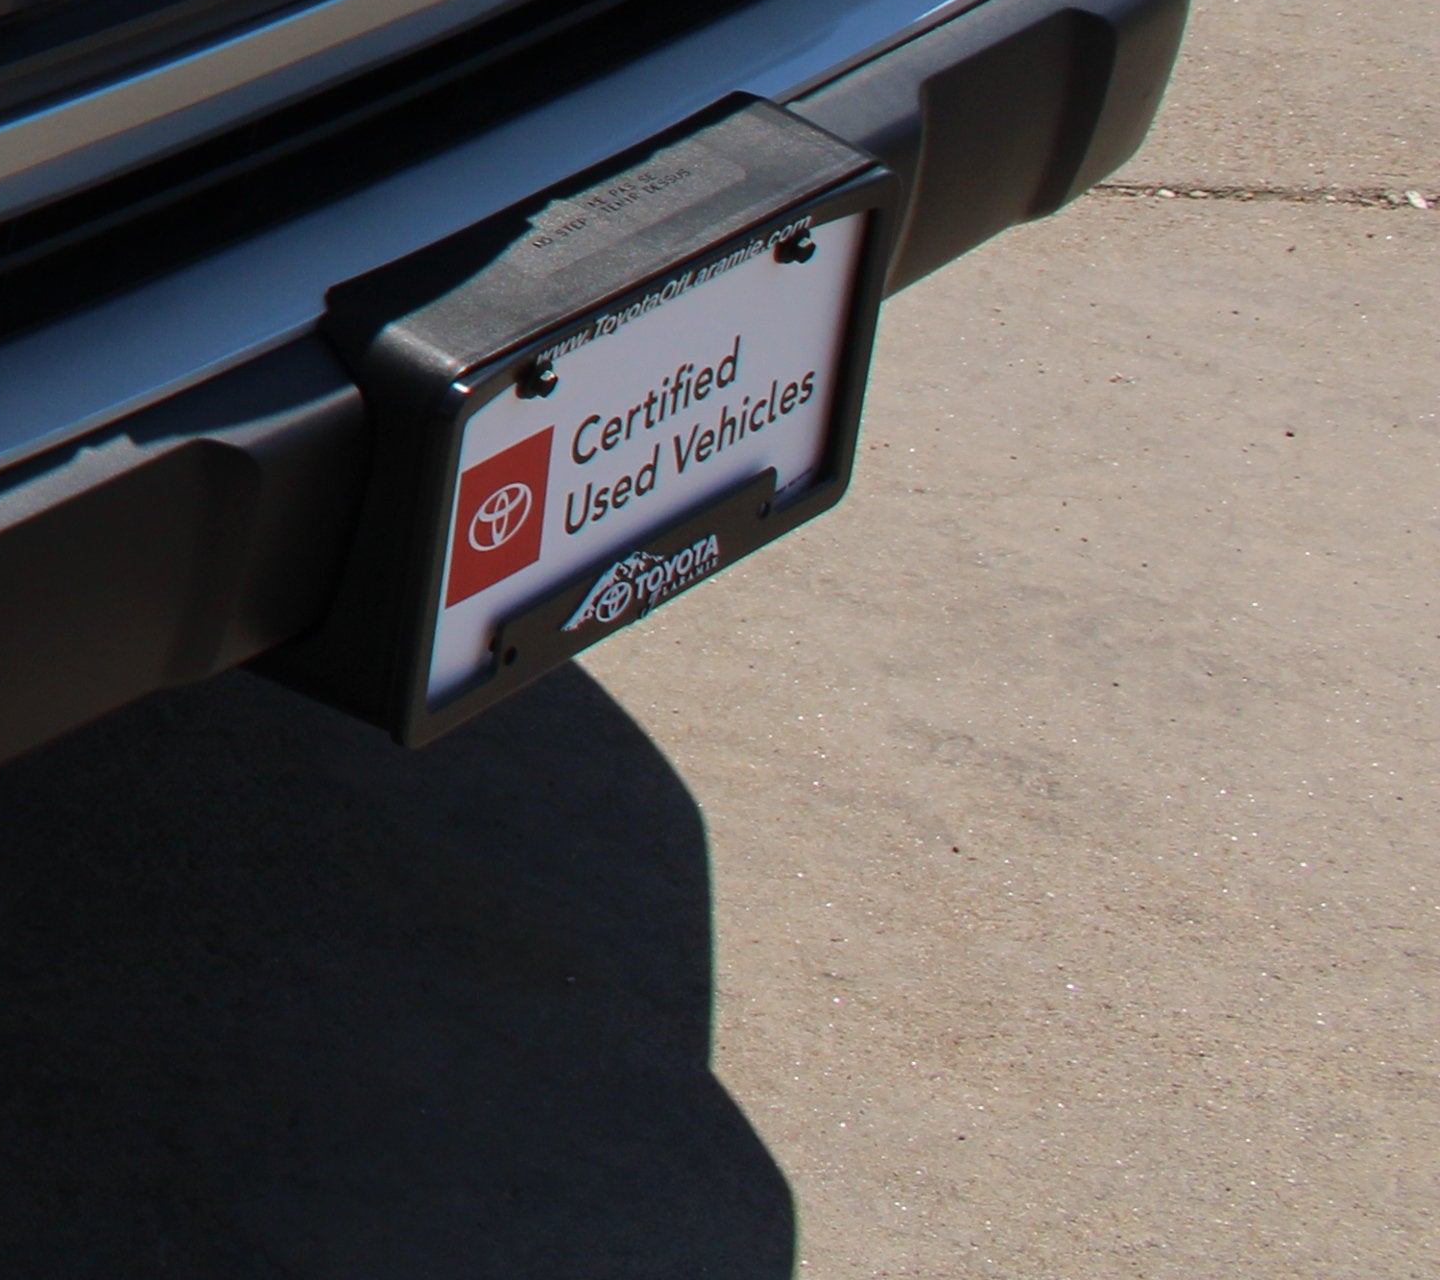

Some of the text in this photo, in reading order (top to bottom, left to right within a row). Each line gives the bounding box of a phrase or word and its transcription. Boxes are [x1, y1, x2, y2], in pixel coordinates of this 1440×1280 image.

[564, 370, 816, 534] Used Vehicles
[571, 335, 740, 464] Certified
[635, 534, 719, 600] TOYOTA
